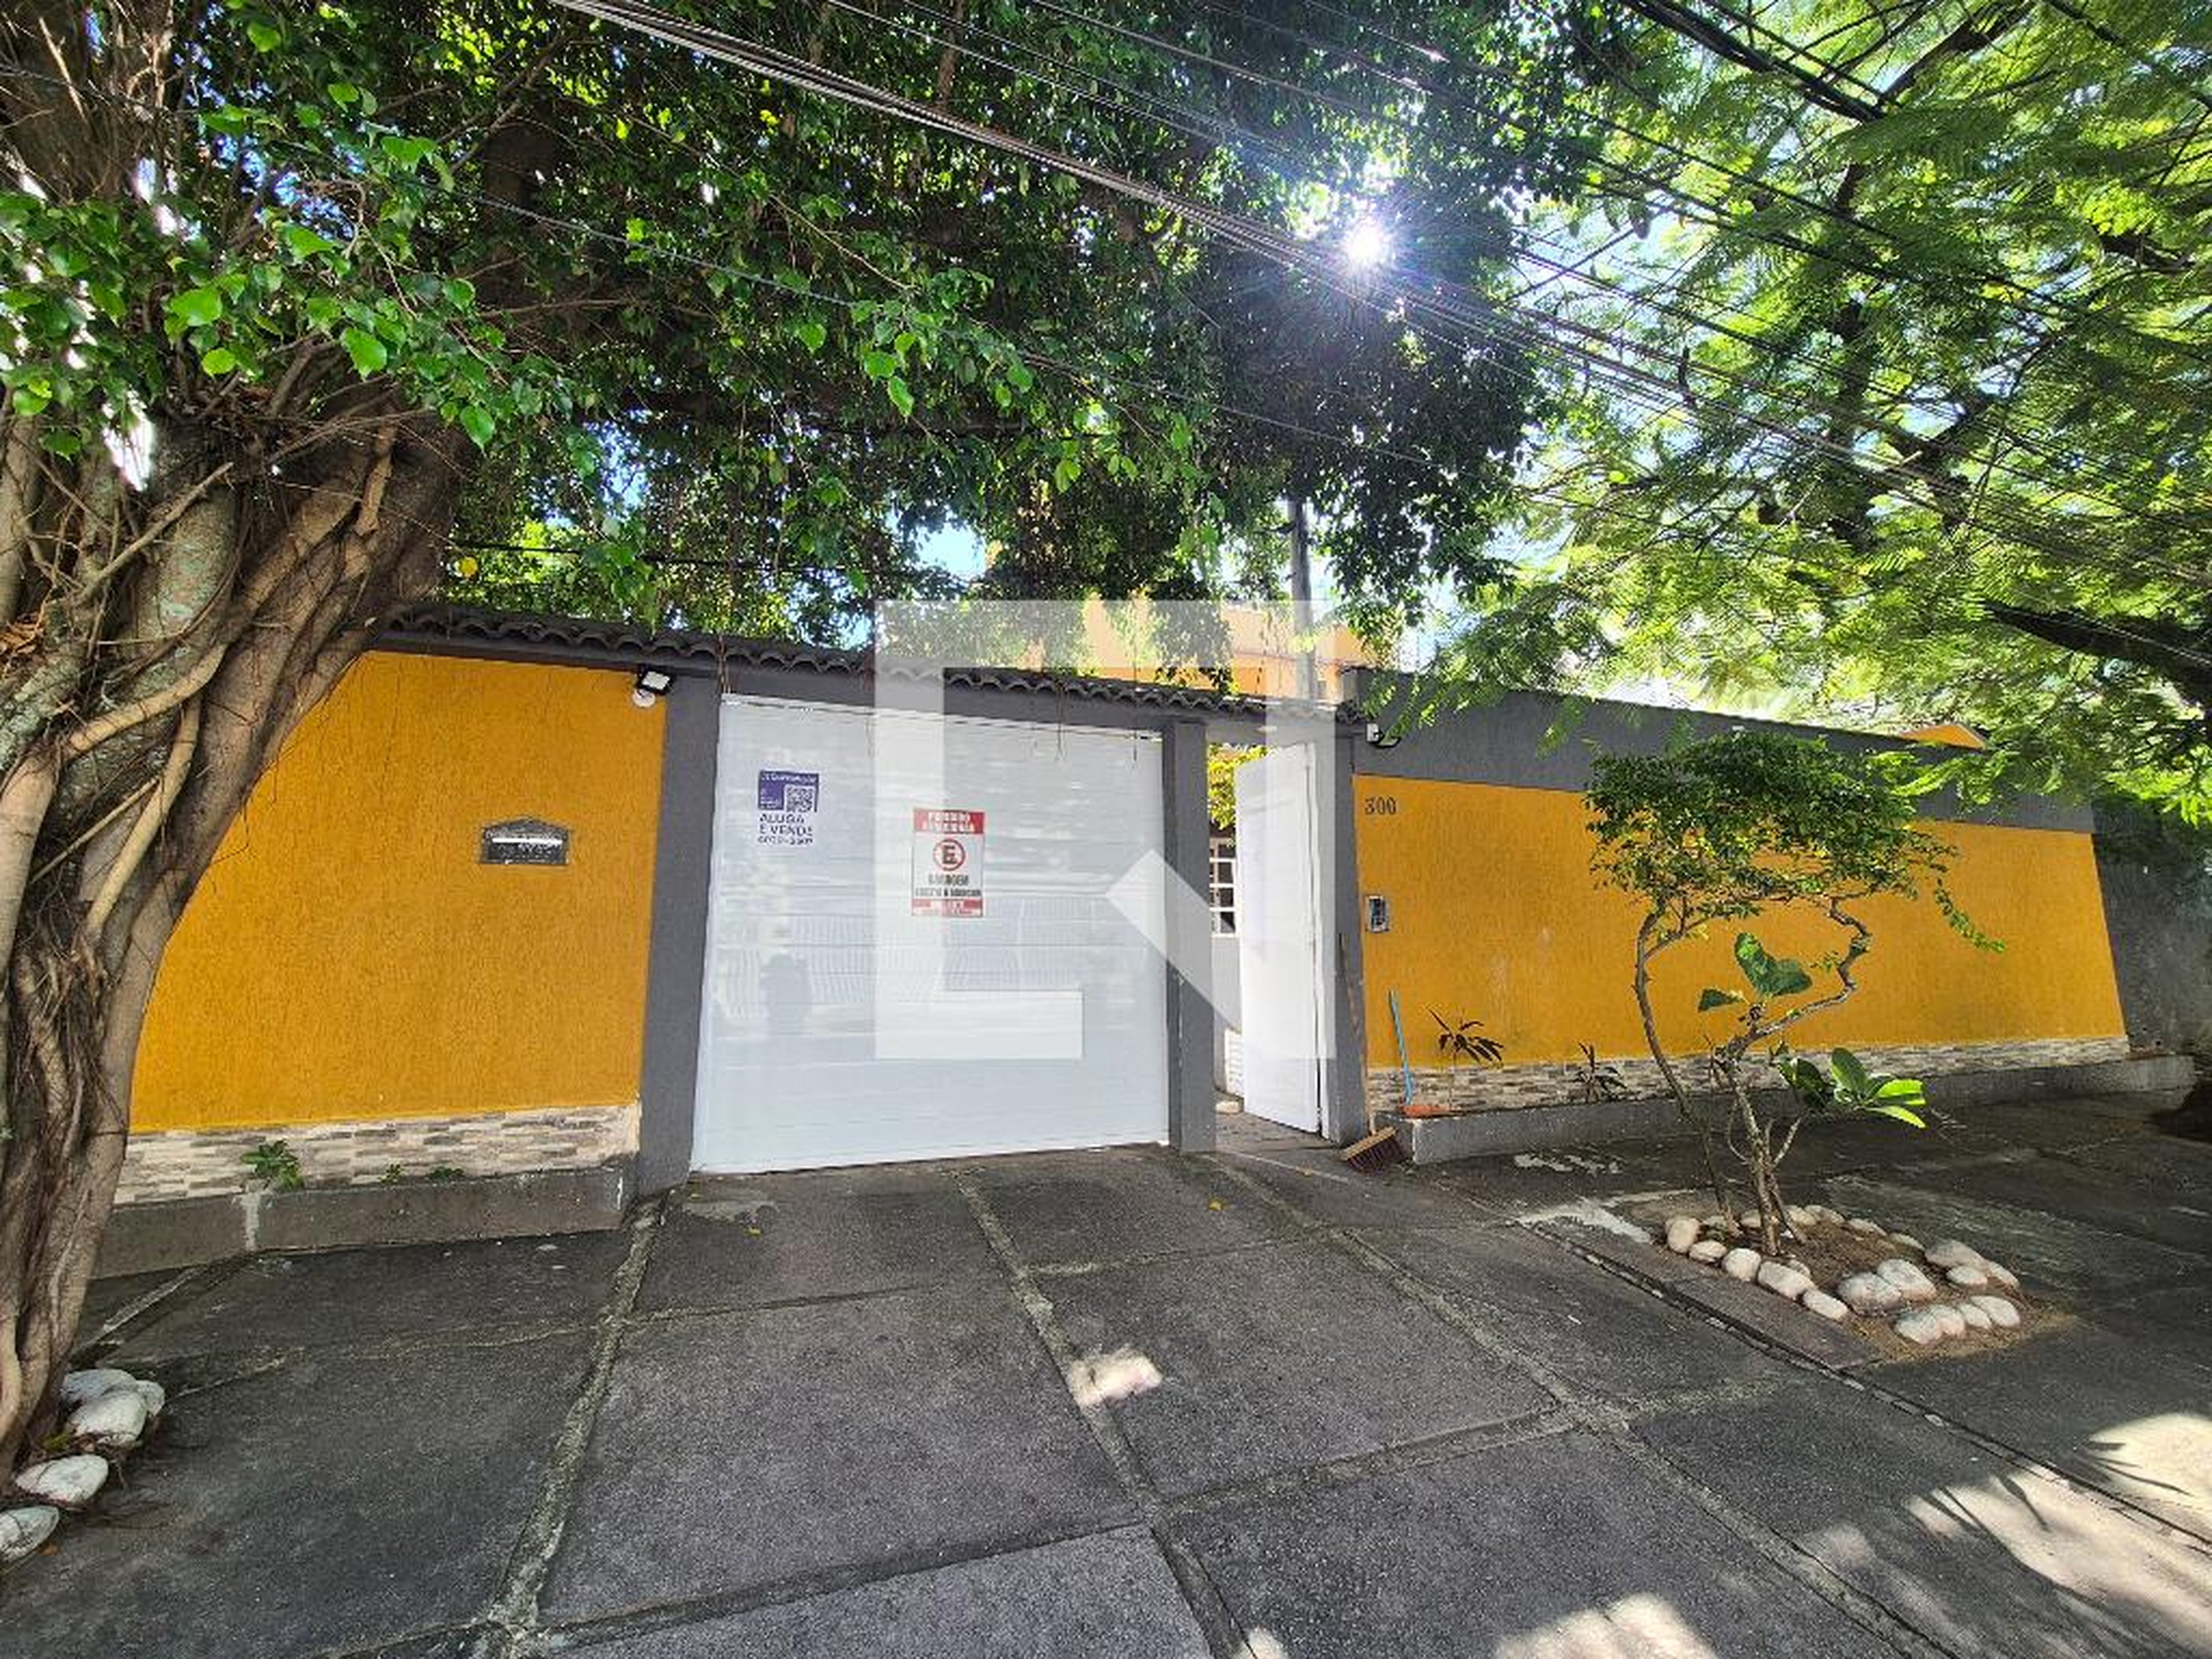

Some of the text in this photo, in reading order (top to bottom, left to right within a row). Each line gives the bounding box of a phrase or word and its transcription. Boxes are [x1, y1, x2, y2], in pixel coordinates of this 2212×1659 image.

[1365, 797, 1396, 815] 300
[760, 813, 805, 824] ALUGA
[942, 845, 957, 865] E
